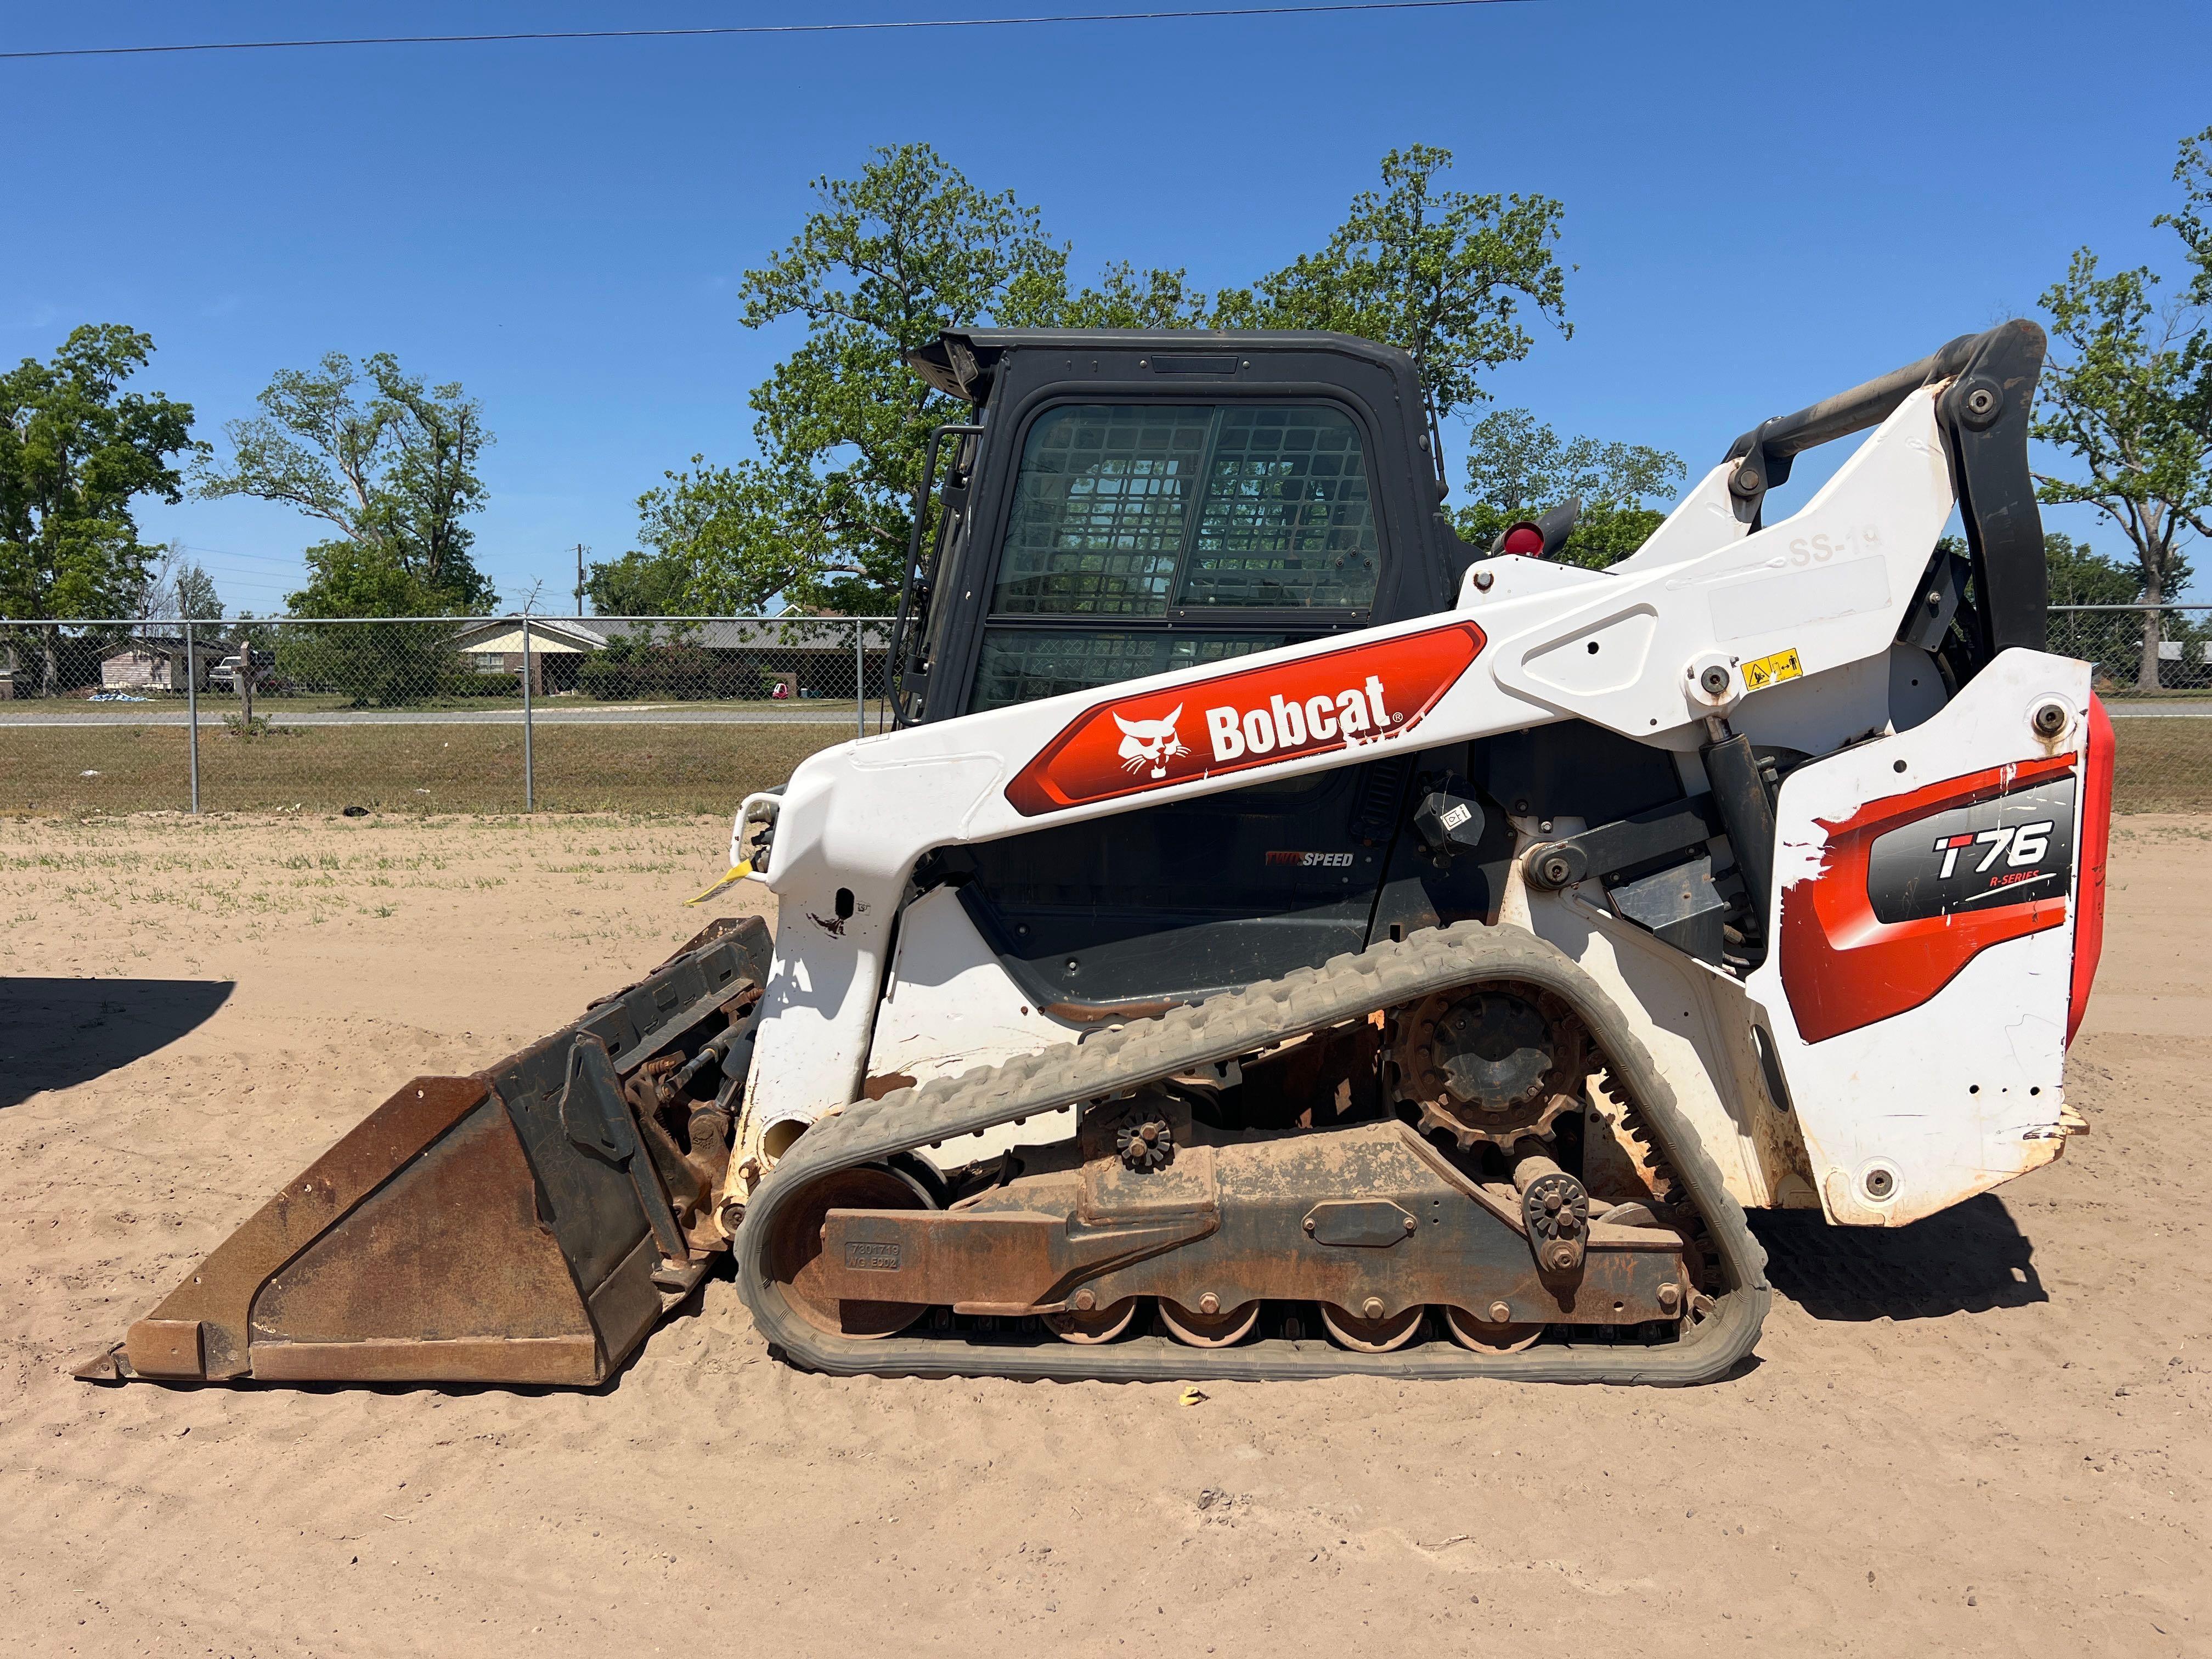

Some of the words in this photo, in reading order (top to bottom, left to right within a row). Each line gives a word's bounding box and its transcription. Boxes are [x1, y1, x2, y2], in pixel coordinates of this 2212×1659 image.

[1205, 675, 1391, 762] Bobcat
[1302, 852, 1354, 867] SPEED
[1933, 820, 2054, 880] T76
[1989, 870, 2040, 887] R-SERIES
